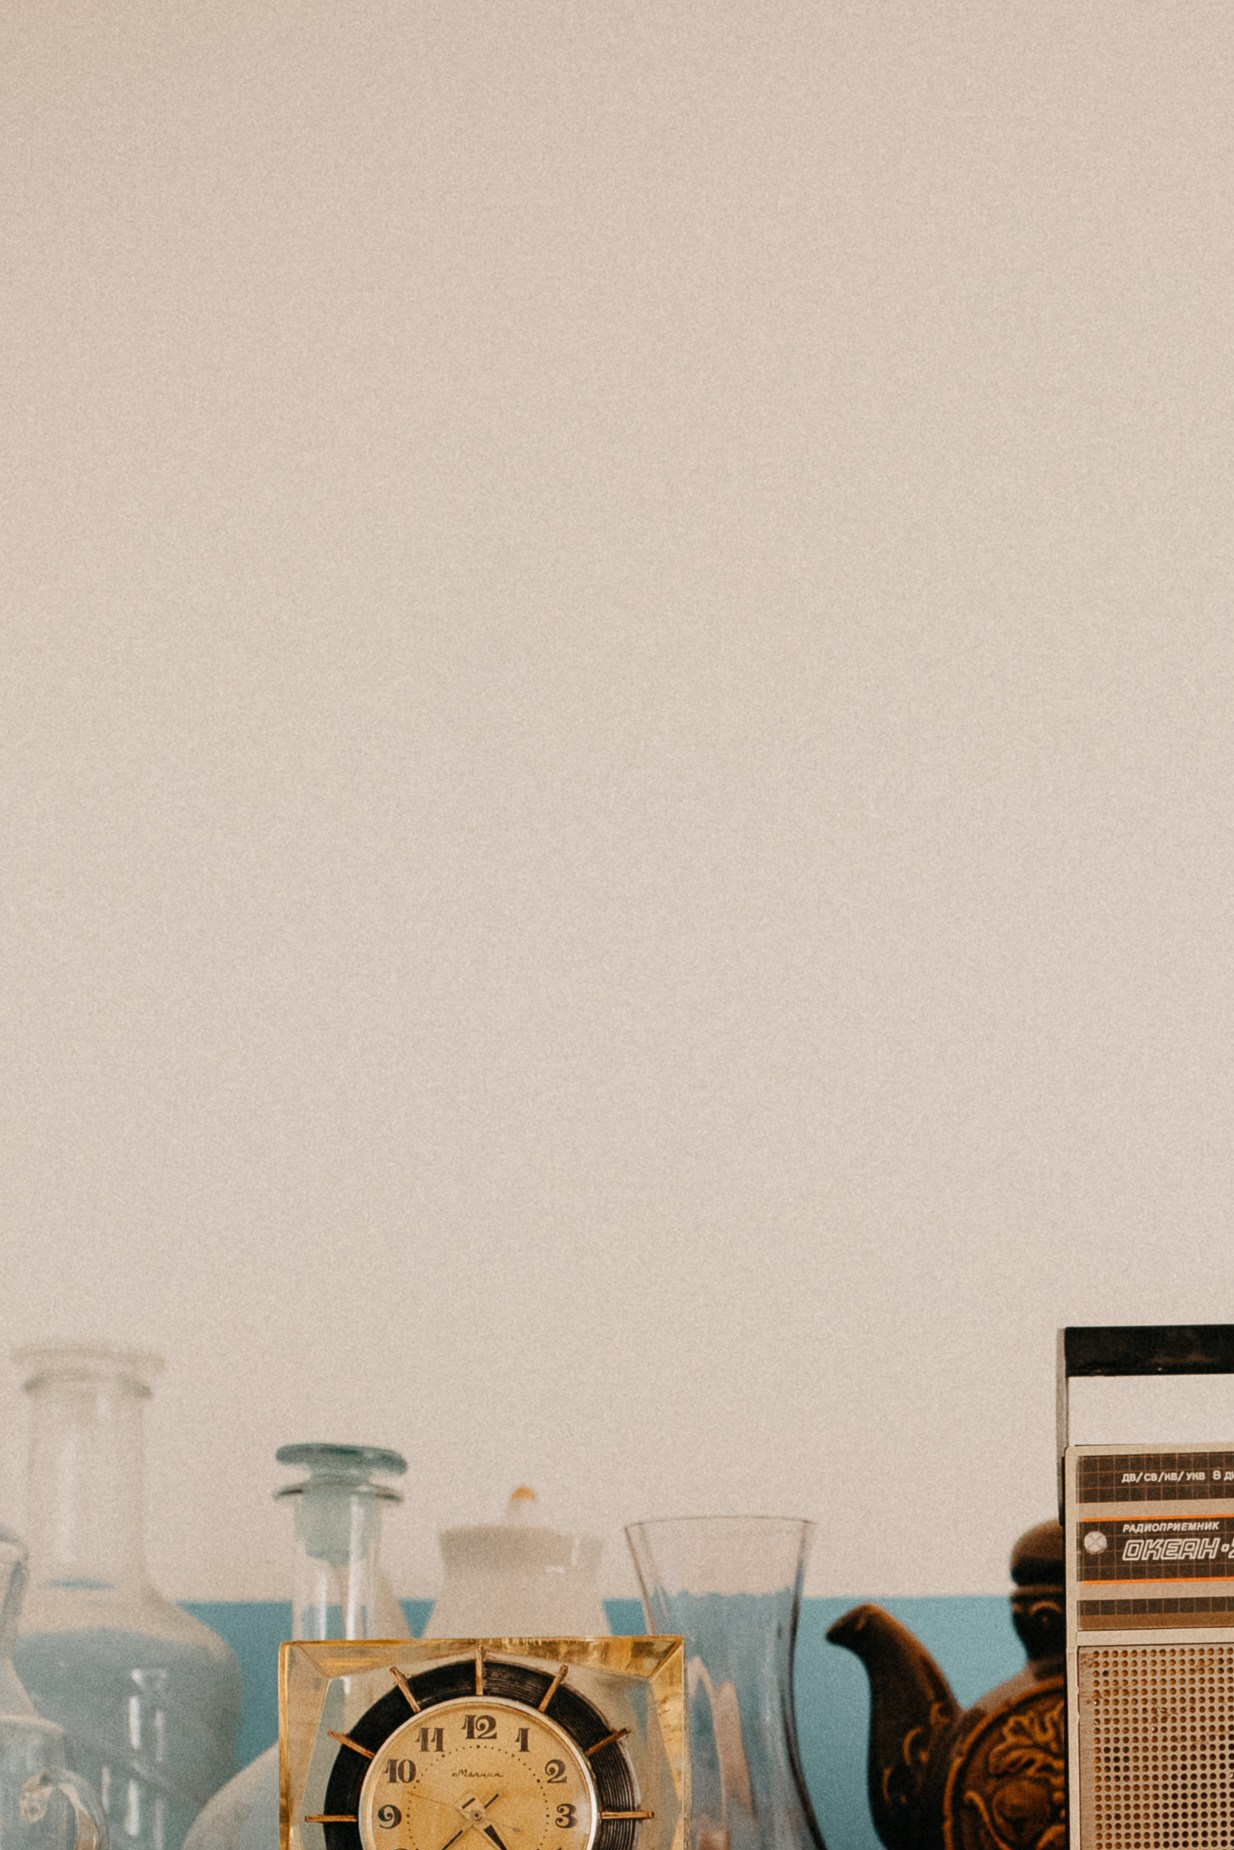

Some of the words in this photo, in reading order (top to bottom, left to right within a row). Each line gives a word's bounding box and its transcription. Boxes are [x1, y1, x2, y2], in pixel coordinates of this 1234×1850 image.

[1186, 1472, 1205, 1480] УКВ
[1213, 1471, 1220, 1480] 8
[1123, 1522, 1219, 1533] РАДИОПРИЕМНИК
[462, 1715, 497, 1740] 12
[416, 1728, 444, 1752] 11
[515, 1728, 530, 1752] 1
[384, 1759, 416, 1783] 10
[545, 1759, 567, 1783] 2
[378, 1805, 402, 1829] 9
[555, 1803, 576, 1828] 3
